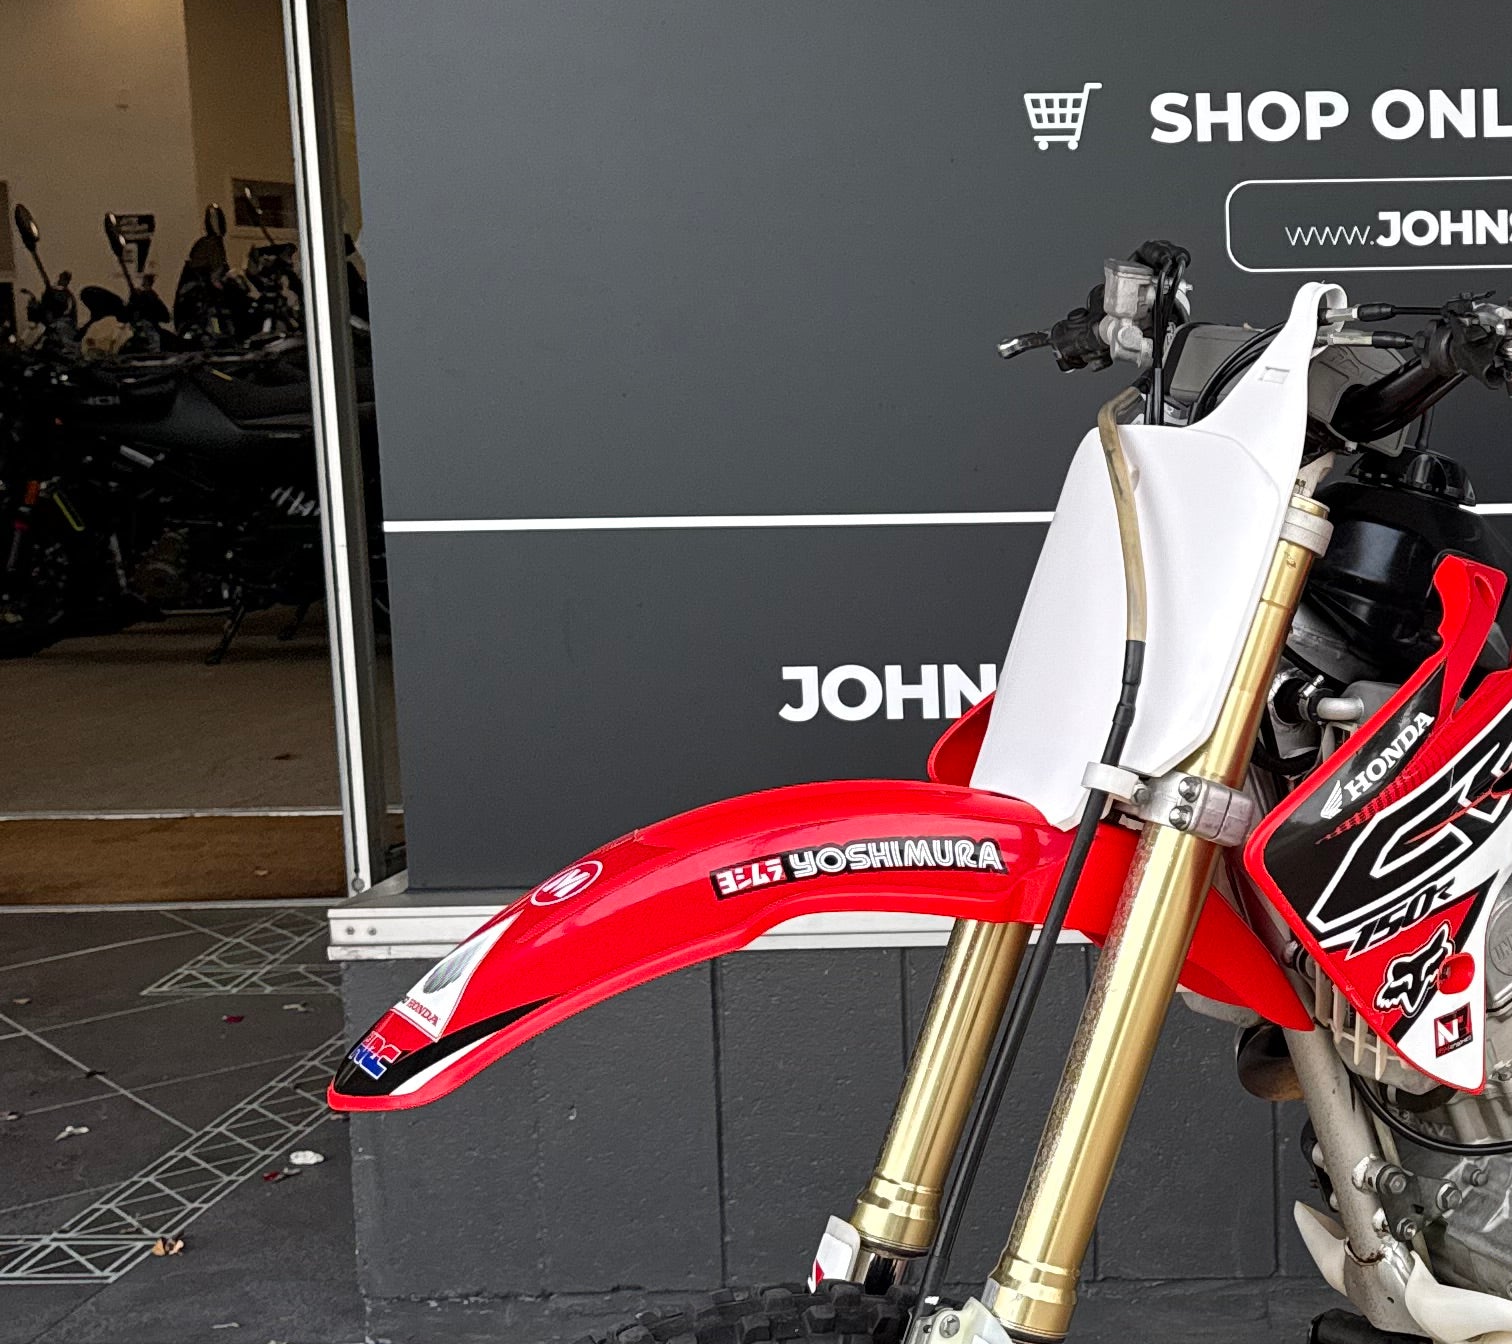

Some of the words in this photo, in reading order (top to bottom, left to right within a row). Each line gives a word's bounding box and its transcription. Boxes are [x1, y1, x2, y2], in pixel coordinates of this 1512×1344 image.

[1150, 90, 1349, 143] SHOP
[1344, 711, 1435, 802] HONDA
[788, 839, 1004, 878] YOSHIMURA
